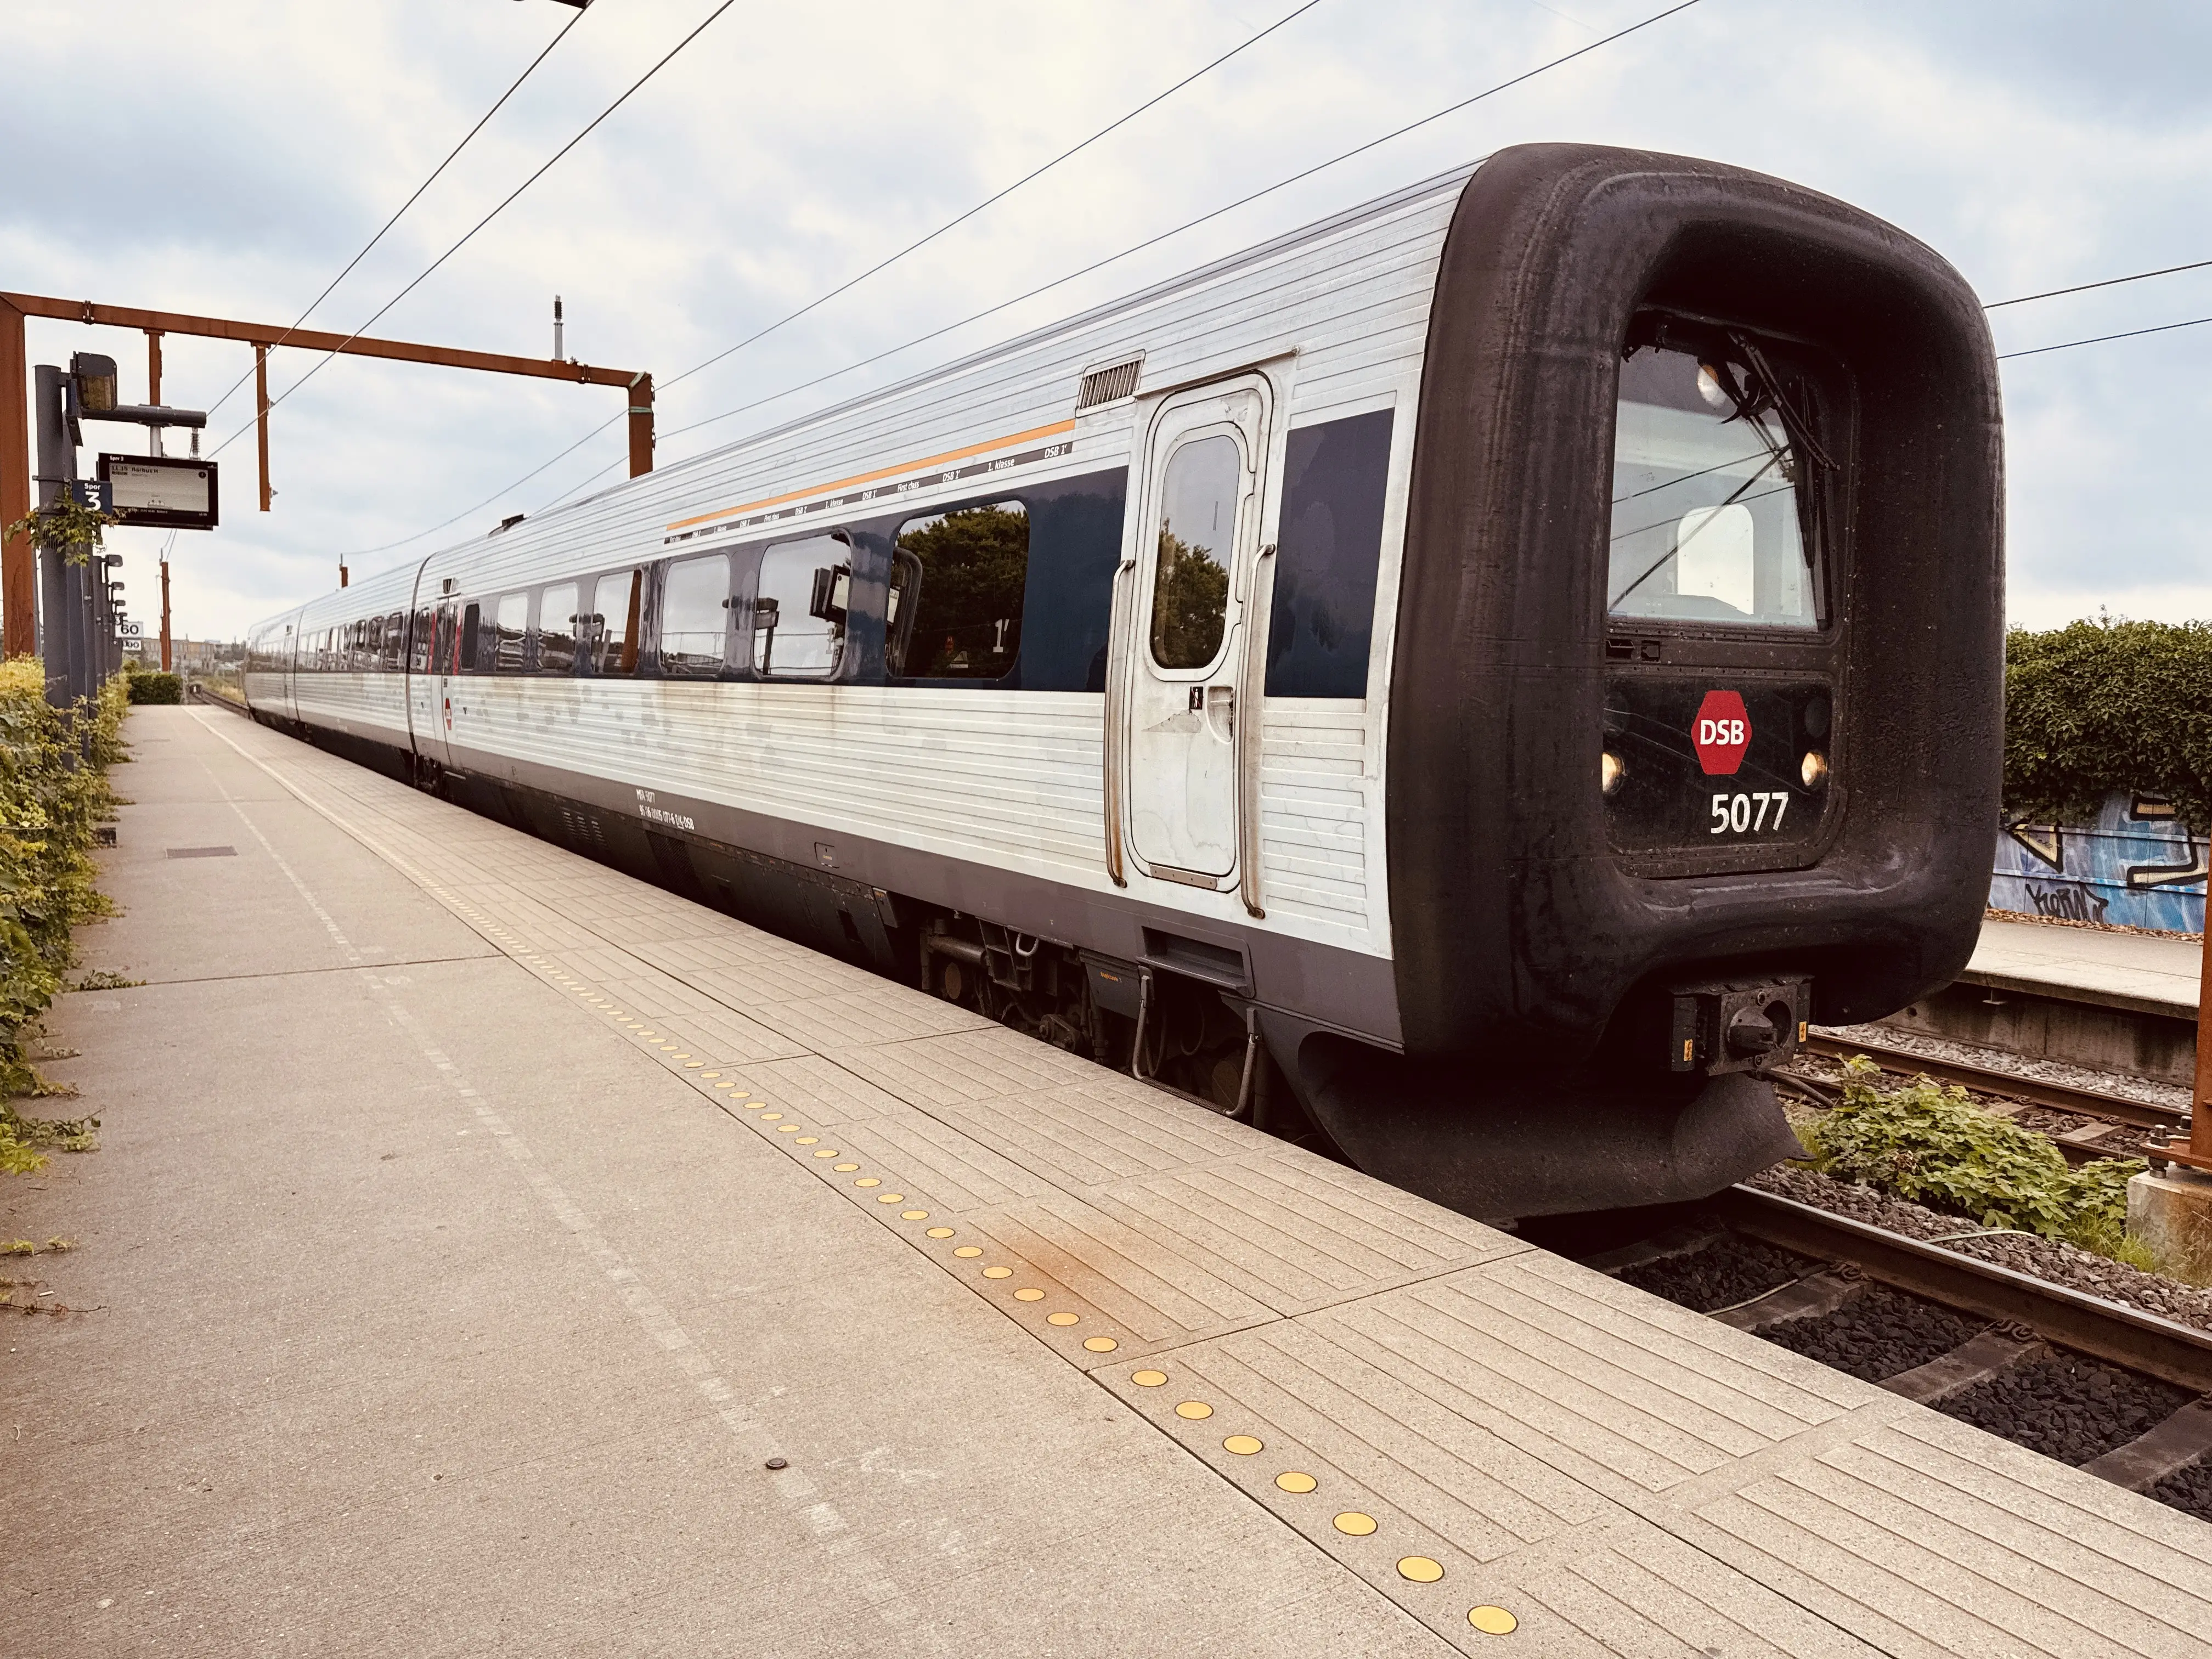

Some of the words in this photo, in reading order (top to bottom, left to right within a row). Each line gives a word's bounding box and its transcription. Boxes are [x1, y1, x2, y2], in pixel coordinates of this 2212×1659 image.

[830, 498, 843, 507] klasse
[862, 492, 872, 500] DSB
[898, 483, 908, 492] First
[908, 481, 919, 490] class
[943, 471, 955, 483] DSB
[988, 462, 994, 472] 1.
[995, 459, 1014, 470] klasse
[1044, 446, 1059, 459] DSB
[86, 491, 101, 511] 3
[121, 624, 139, 635] 60
[1700, 719, 1744, 745] DSB
[675, 814, 694, 830] DK-DSB
[1711, 792, 1788, 834] 5077
